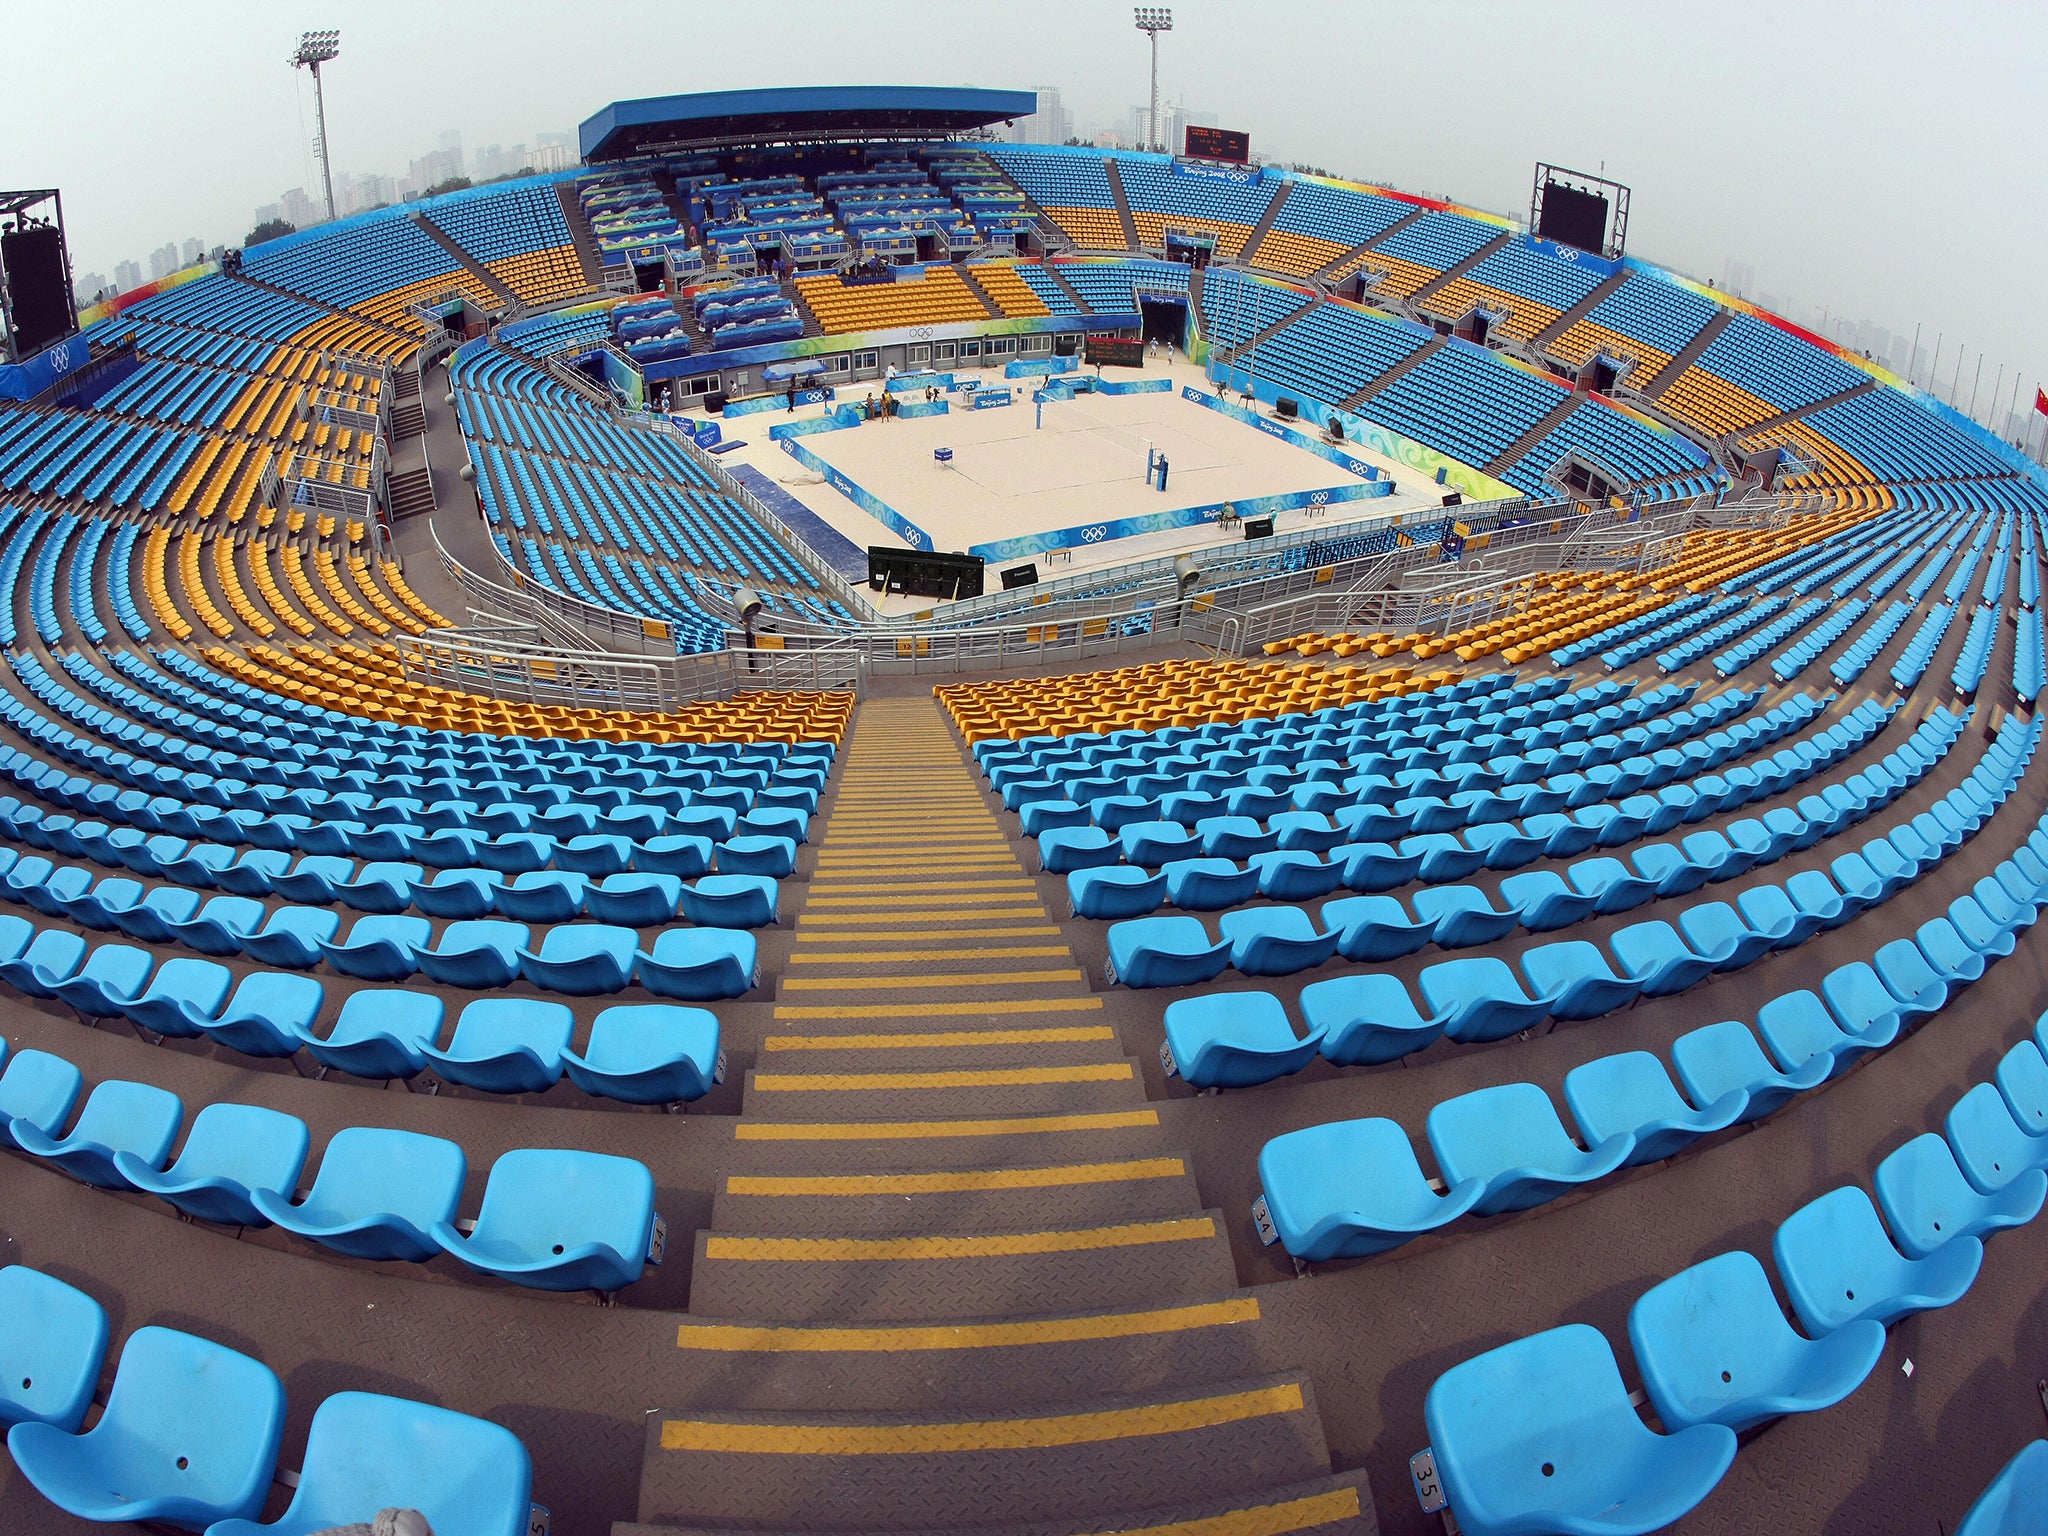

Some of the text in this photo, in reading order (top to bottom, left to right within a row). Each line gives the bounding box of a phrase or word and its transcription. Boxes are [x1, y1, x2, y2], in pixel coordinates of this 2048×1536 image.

[1182, 166, 1226, 179] Beijing 2008
[980, 399, 997, 407] Beijing
[1259, 420, 1273, 432] Beijing
[1161, 1048, 1172, 1068] 33
[1255, 1208, 1270, 1234] 34
[653, 1229, 664, 1254] 34
[1416, 1468, 1438, 1497] 35
